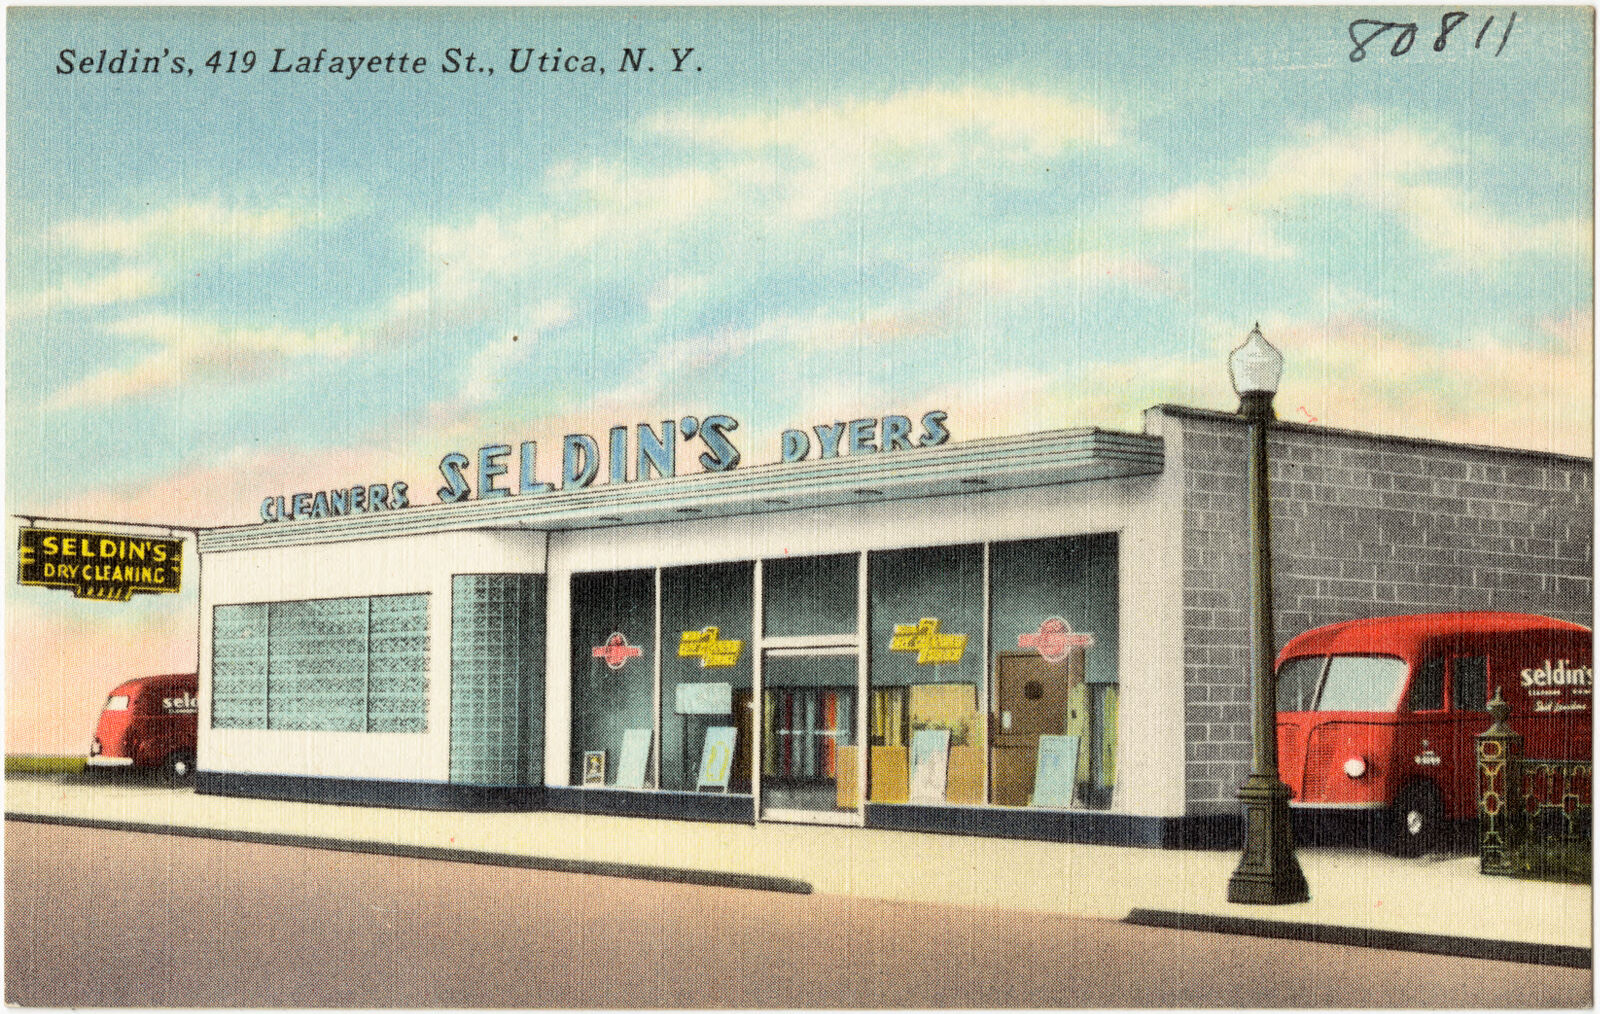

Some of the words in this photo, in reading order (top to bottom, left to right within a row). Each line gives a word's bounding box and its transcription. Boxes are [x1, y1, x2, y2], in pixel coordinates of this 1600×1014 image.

[260, 481, 410, 523] CLEANERS
[437, 414, 741, 503] SELDIN'S
[781, 410, 950, 464] DYERS
[43, 536, 167, 562] SELDIN'S
[43, 563, 80, 579] DRY
[82, 564, 165, 583] CLEANING
